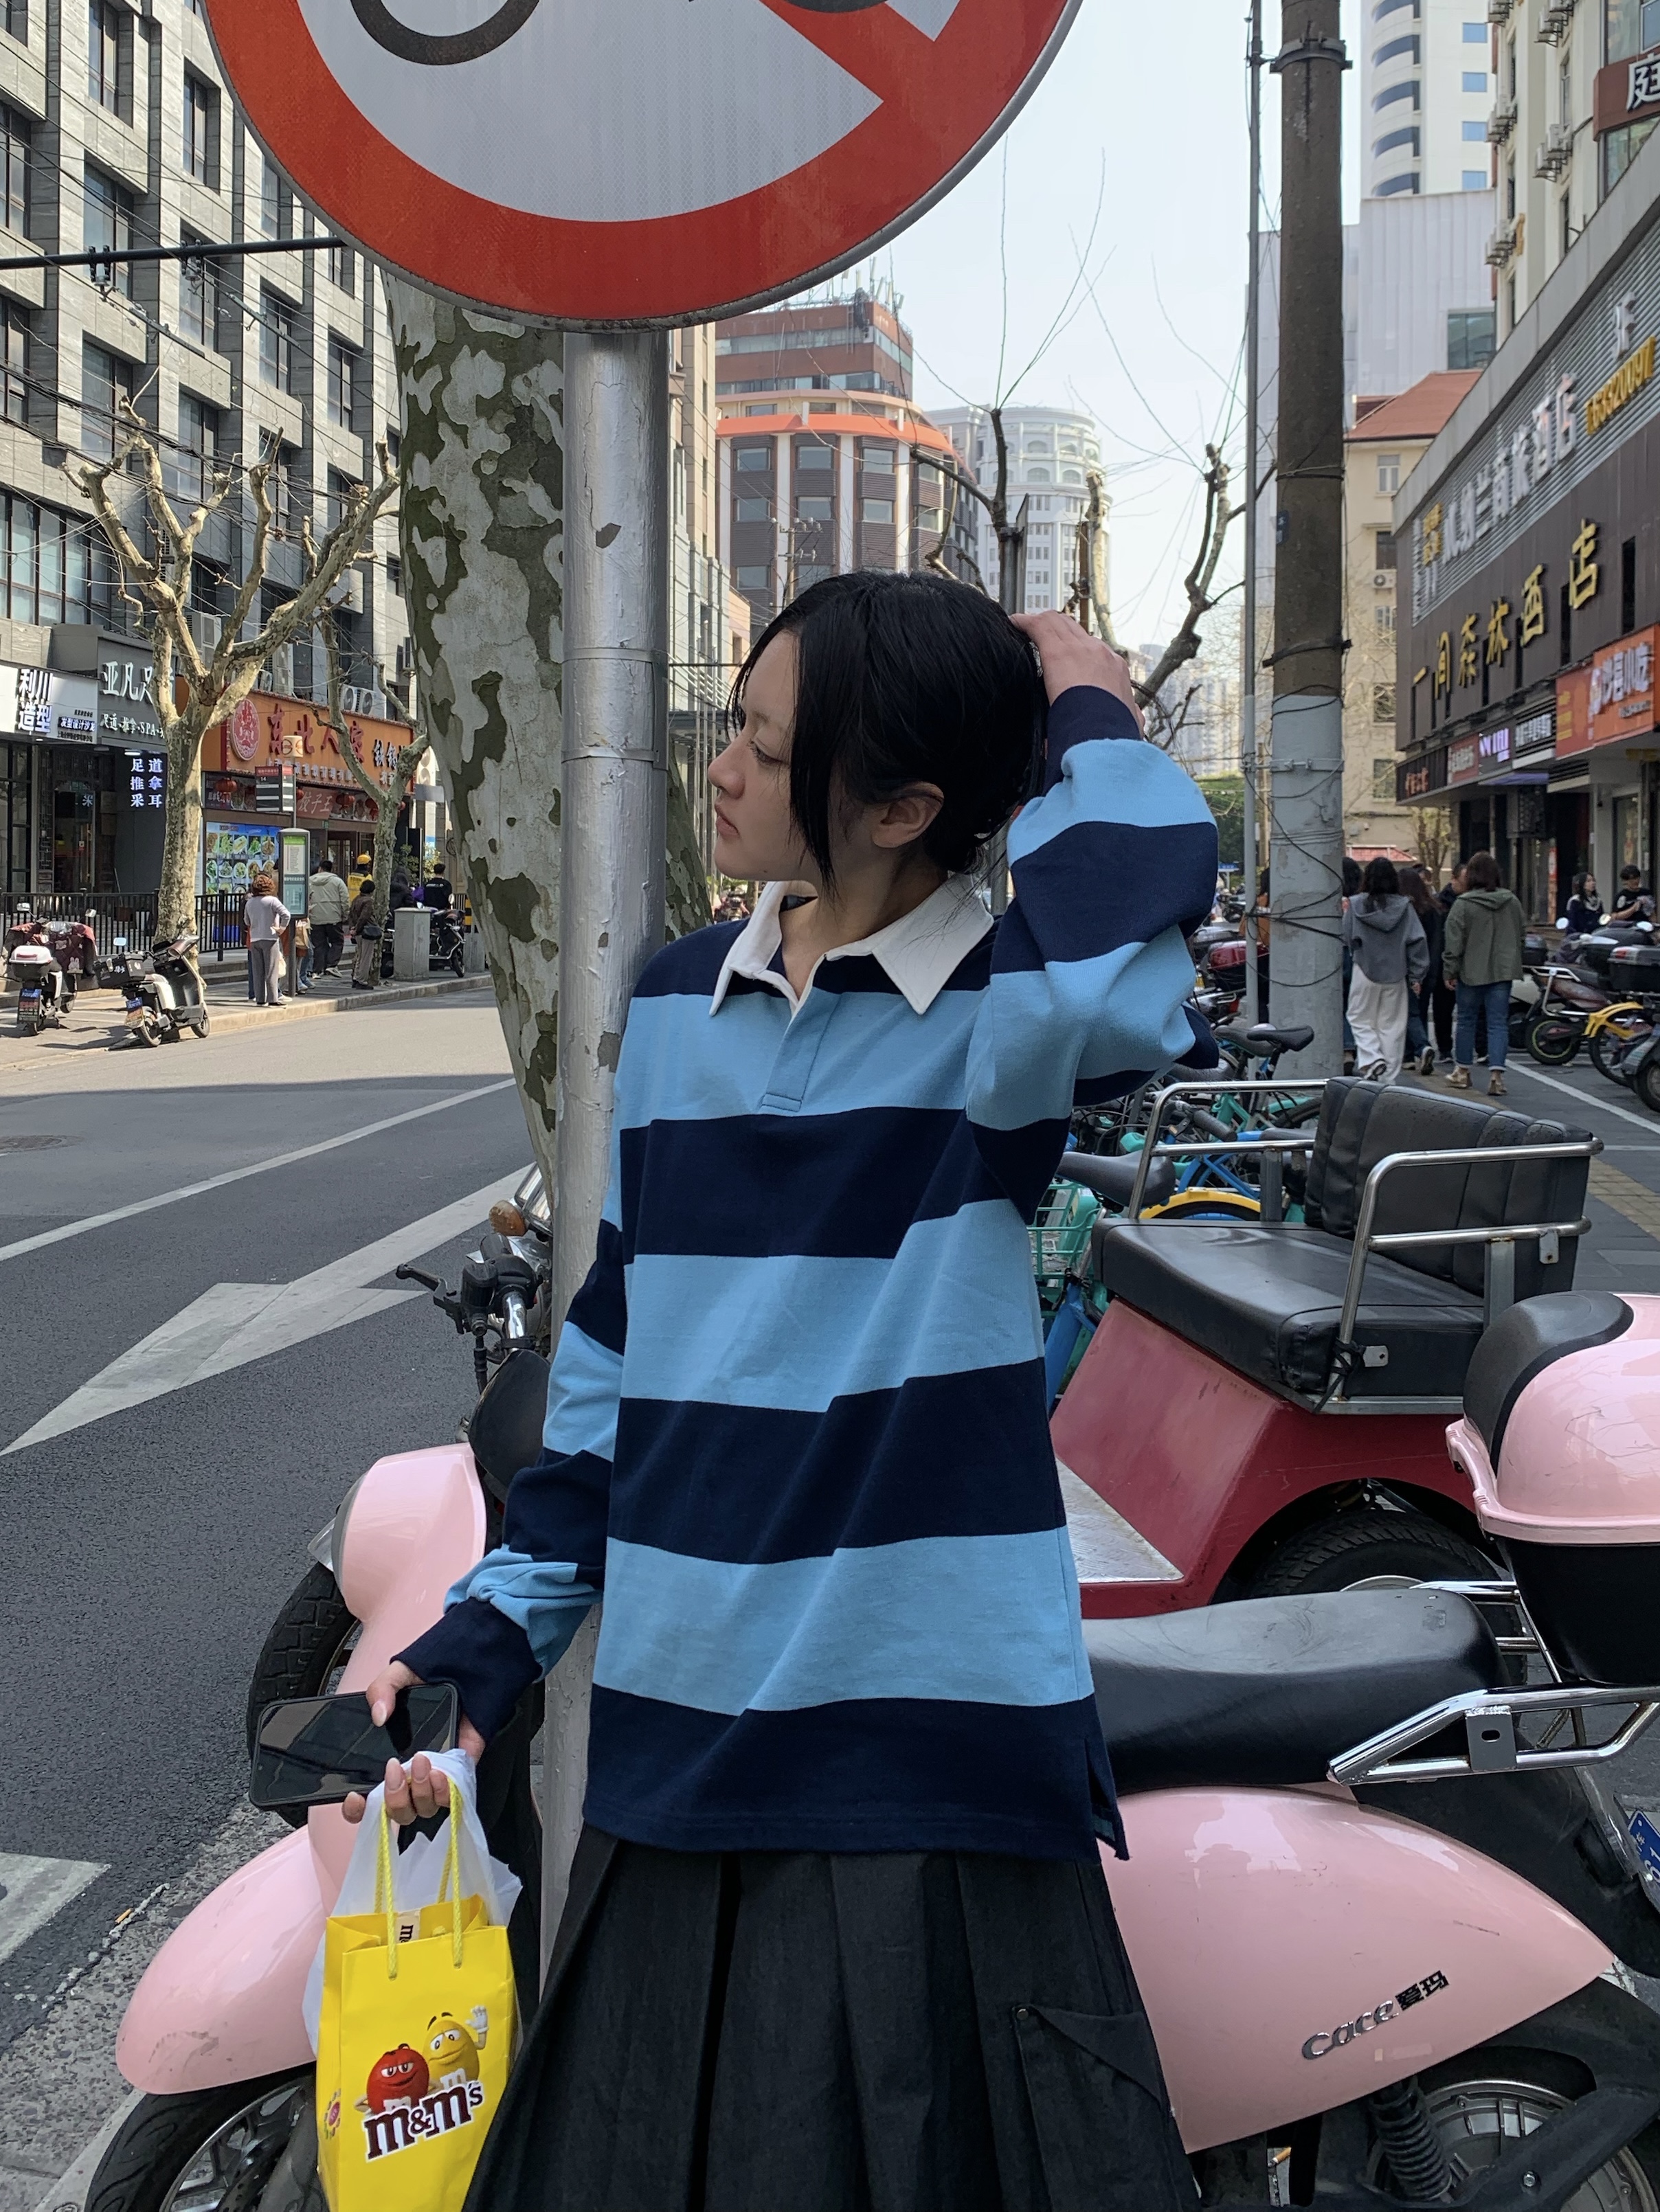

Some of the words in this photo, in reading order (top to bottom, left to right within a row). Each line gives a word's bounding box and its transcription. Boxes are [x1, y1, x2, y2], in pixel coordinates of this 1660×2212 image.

[19, 668, 53, 703] 利川
[101, 661, 174, 705] 亚凡足
[18, 701, 52, 733] 造型
[131, 758, 163, 773] 足道
[373, 737, 405, 770] 铁锅
[130, 776, 163, 791] 推拿
[131, 793, 163, 808] 采耳
[1395, 1970, 1450, 2011] 爱玛
